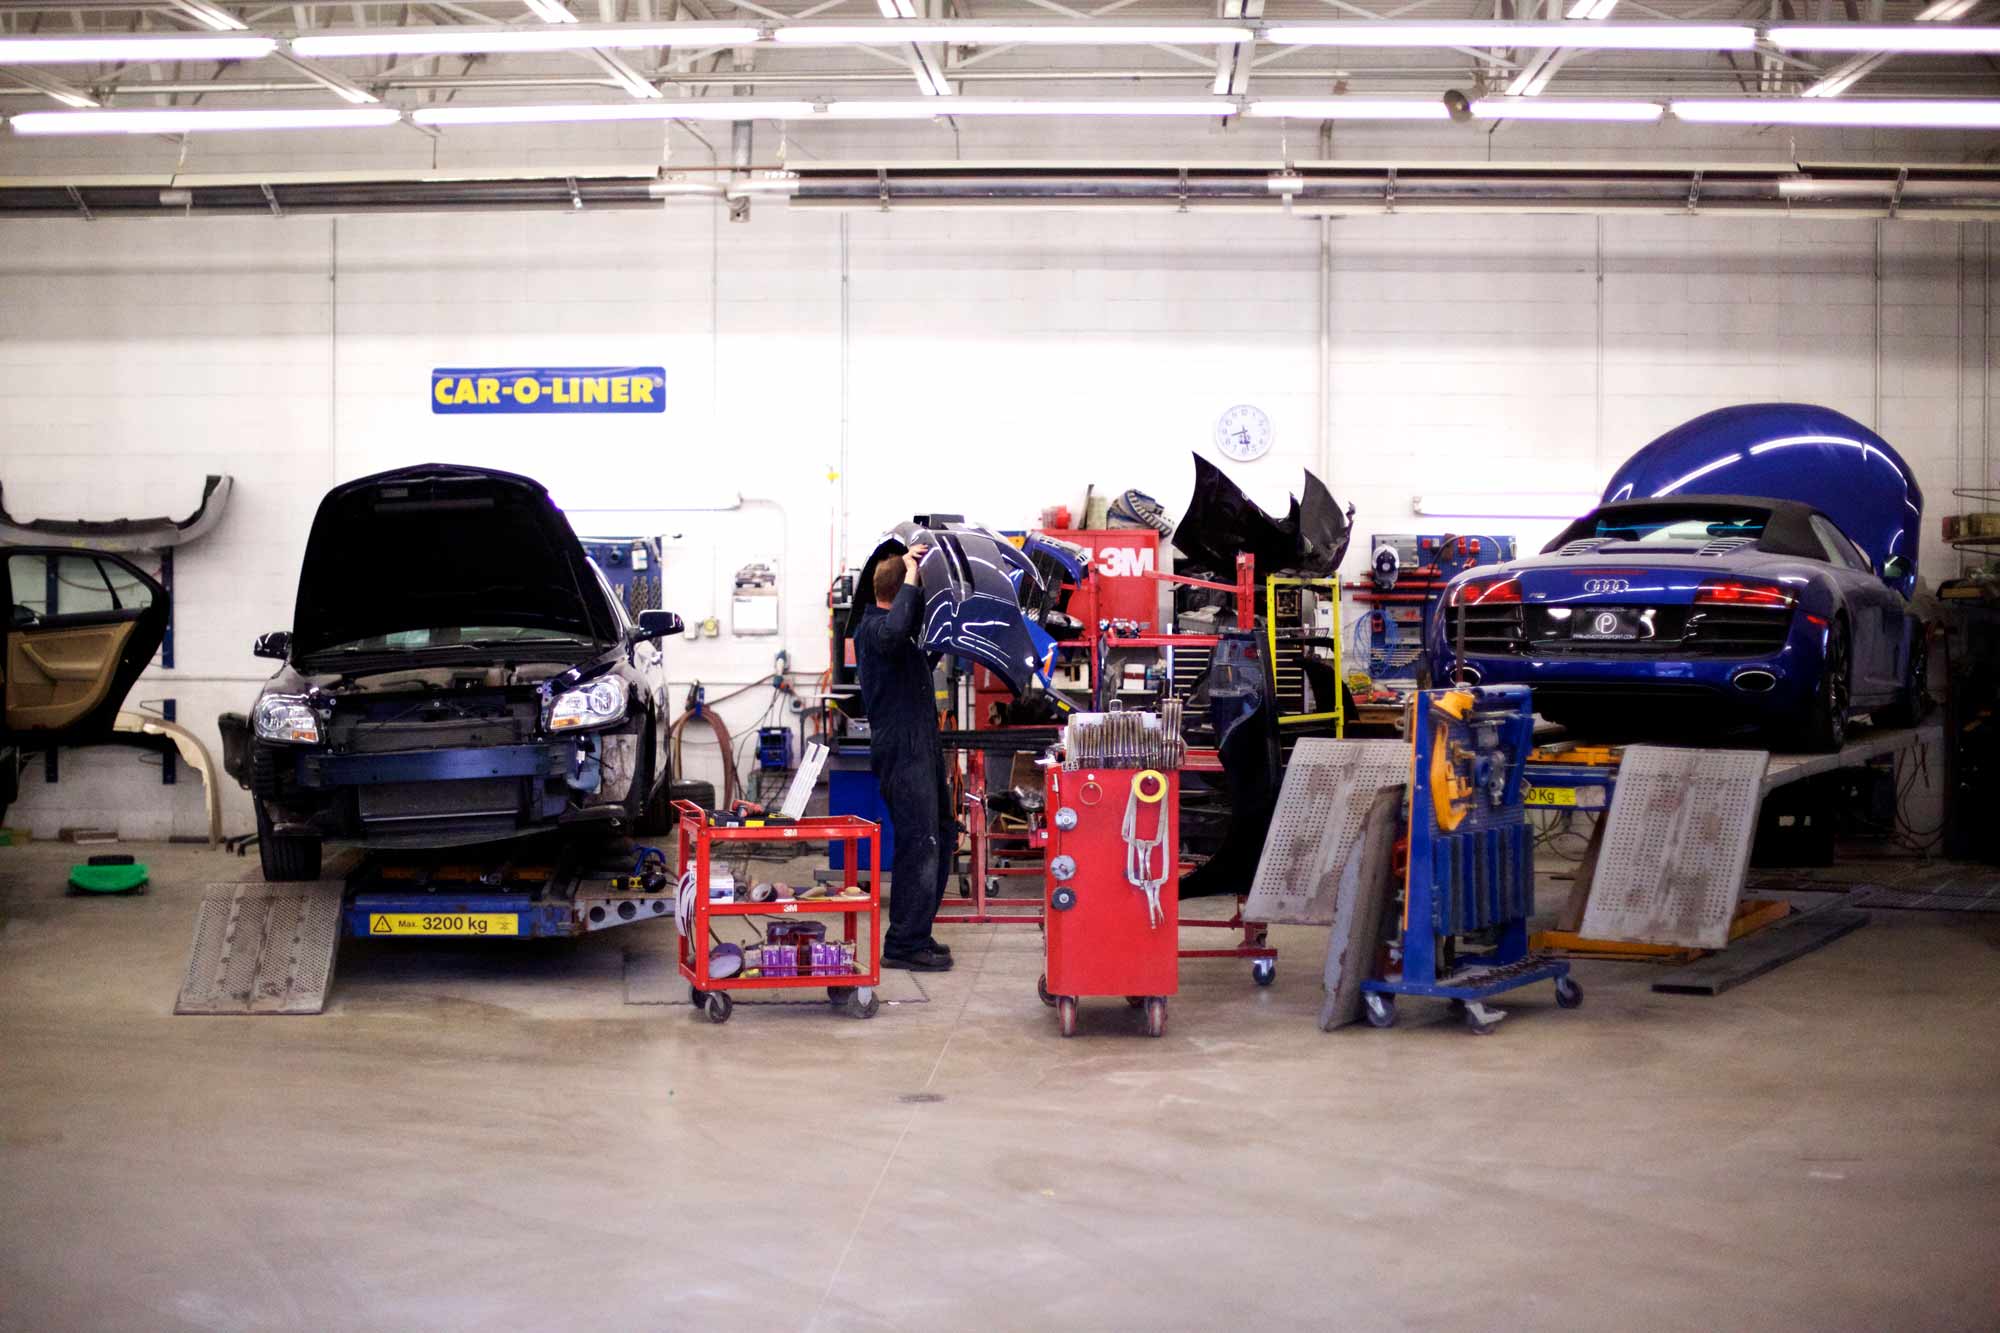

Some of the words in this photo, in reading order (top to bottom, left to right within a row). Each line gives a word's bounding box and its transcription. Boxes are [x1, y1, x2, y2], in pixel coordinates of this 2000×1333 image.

[1099, 547, 1154, 577] 3M
[1539, 788, 1555, 804] Kg
[784, 904, 797, 912] 3M
[422, 917, 464, 930] 3200
[468, 917, 488, 933] kg
